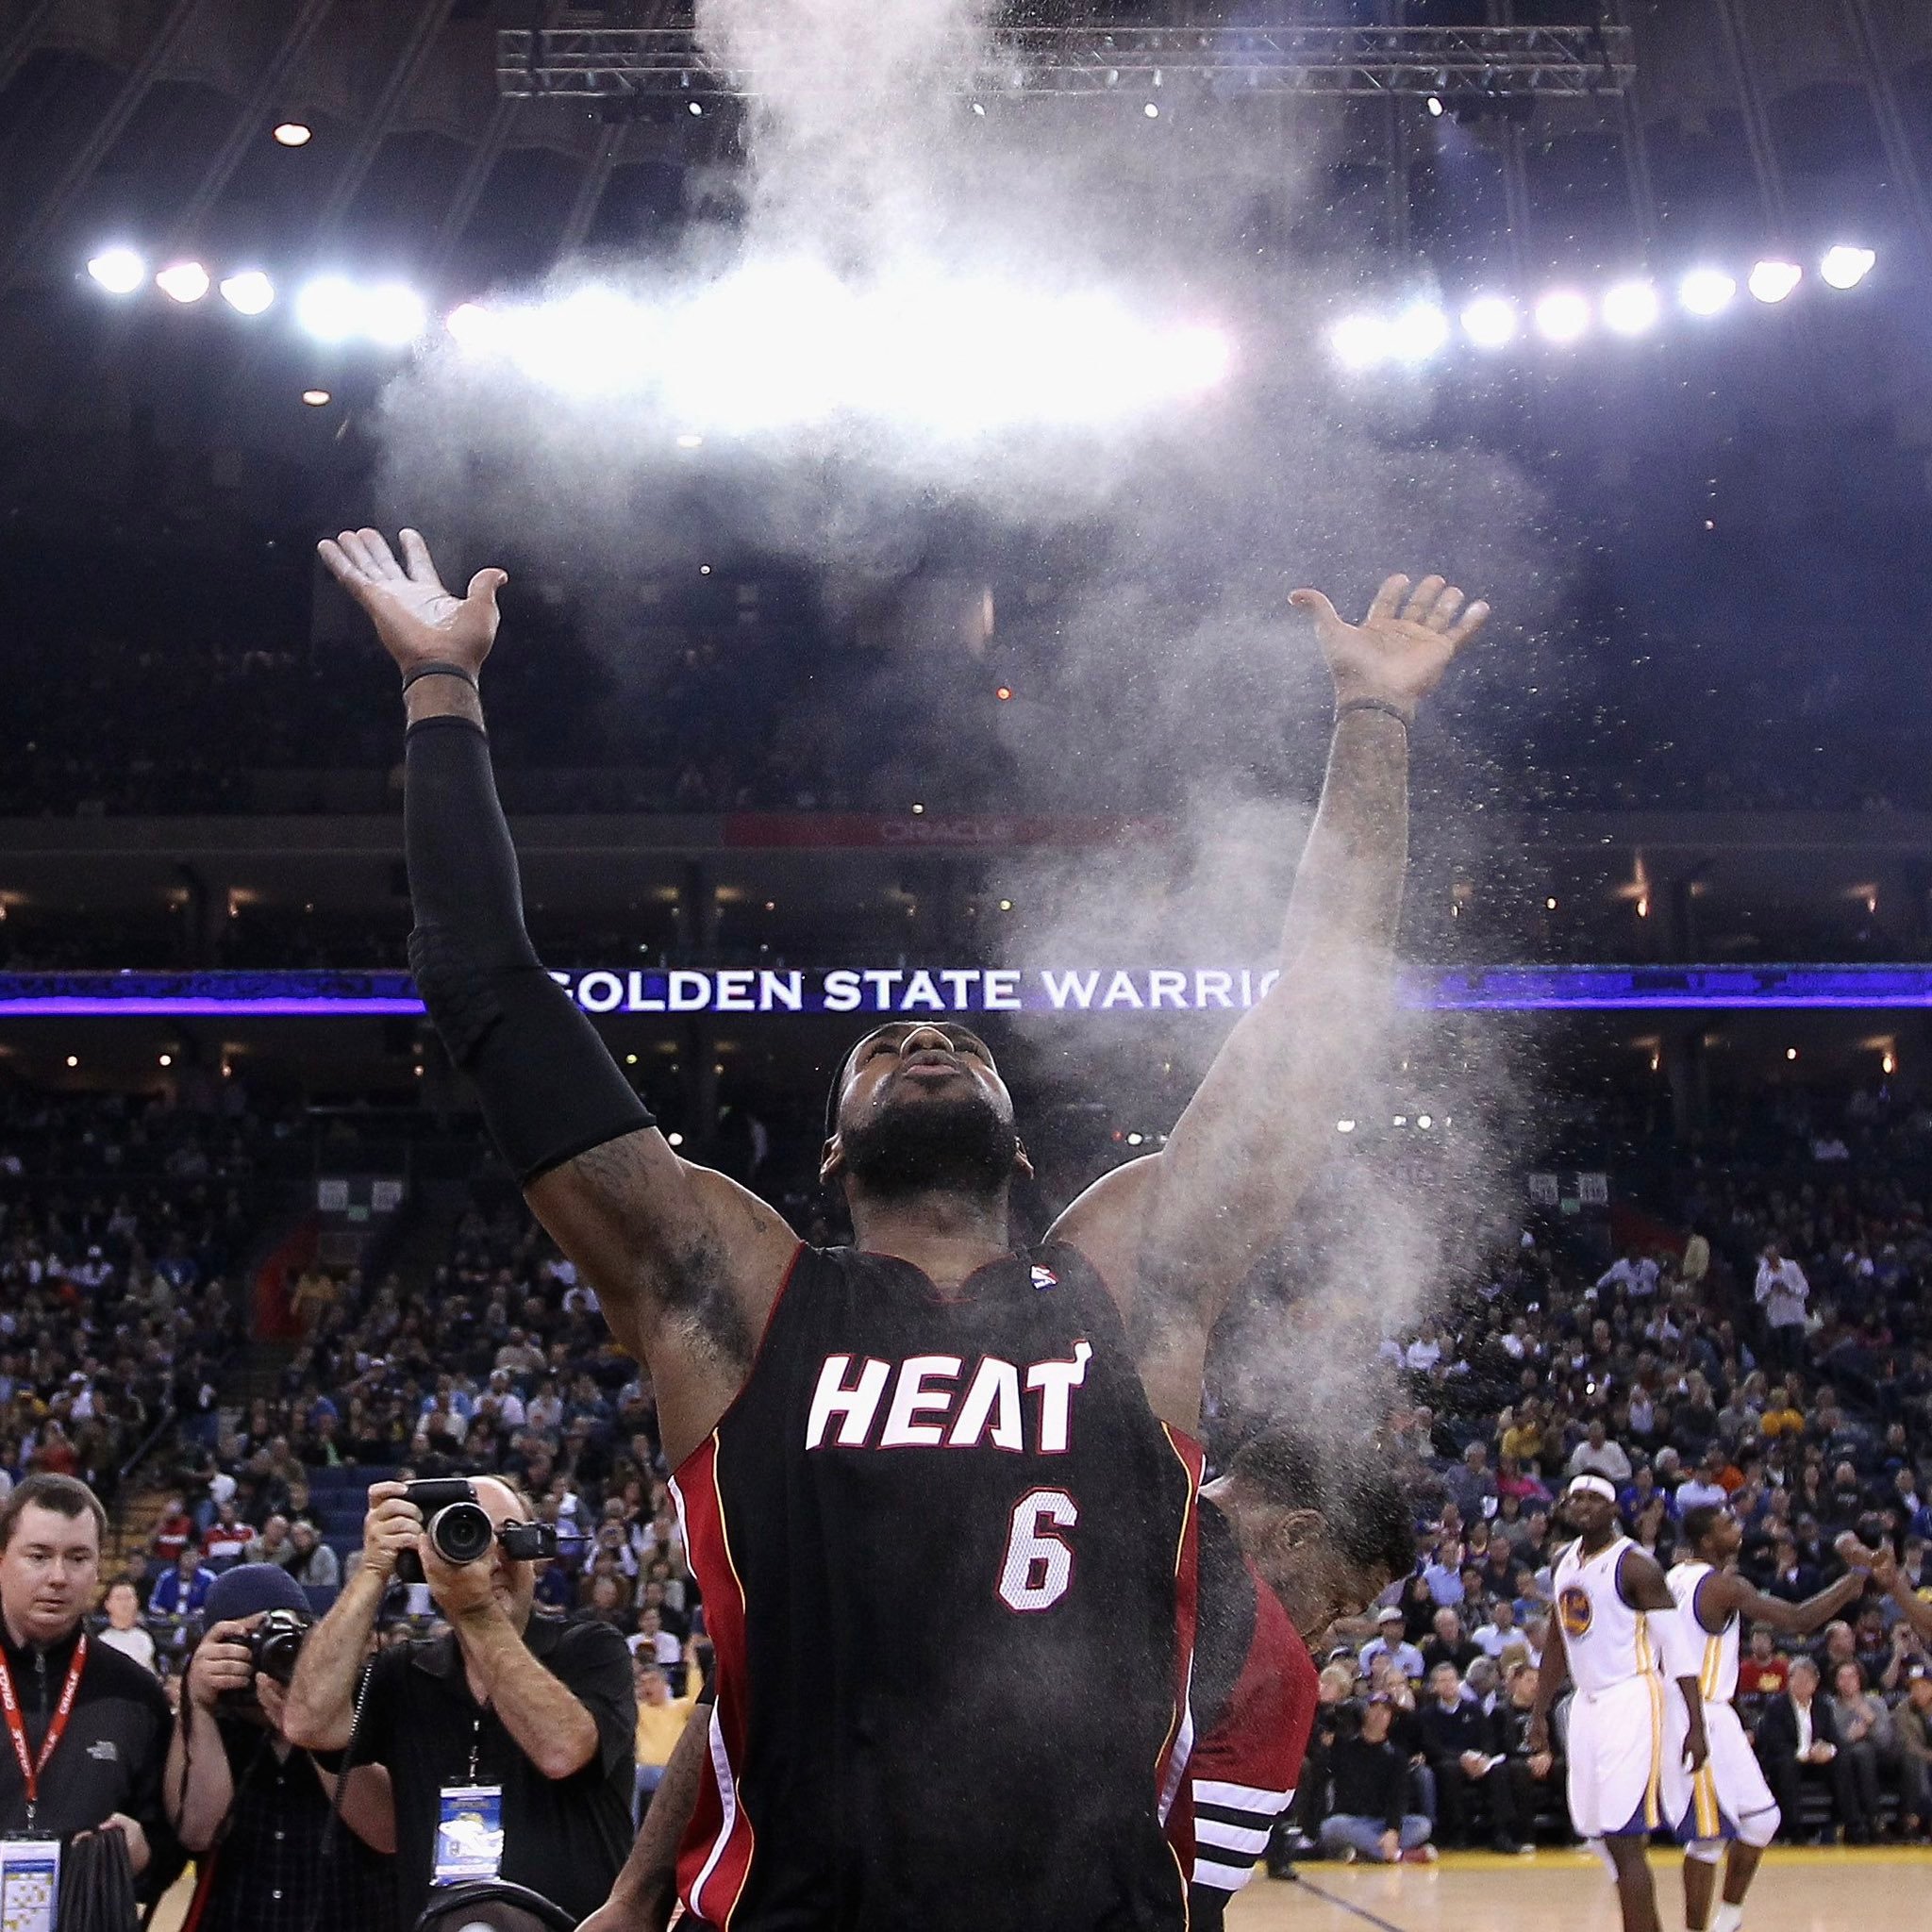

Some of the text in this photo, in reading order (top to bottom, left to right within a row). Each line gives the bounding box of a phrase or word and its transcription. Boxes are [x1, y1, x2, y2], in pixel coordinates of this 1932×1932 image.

[880, 821, 1014, 841] ORACLE
[824, 970, 1022, 1011] STATE
[805, 1338, 1093, 1455] HEAT
[997, 1486, 1079, 1614] 6
